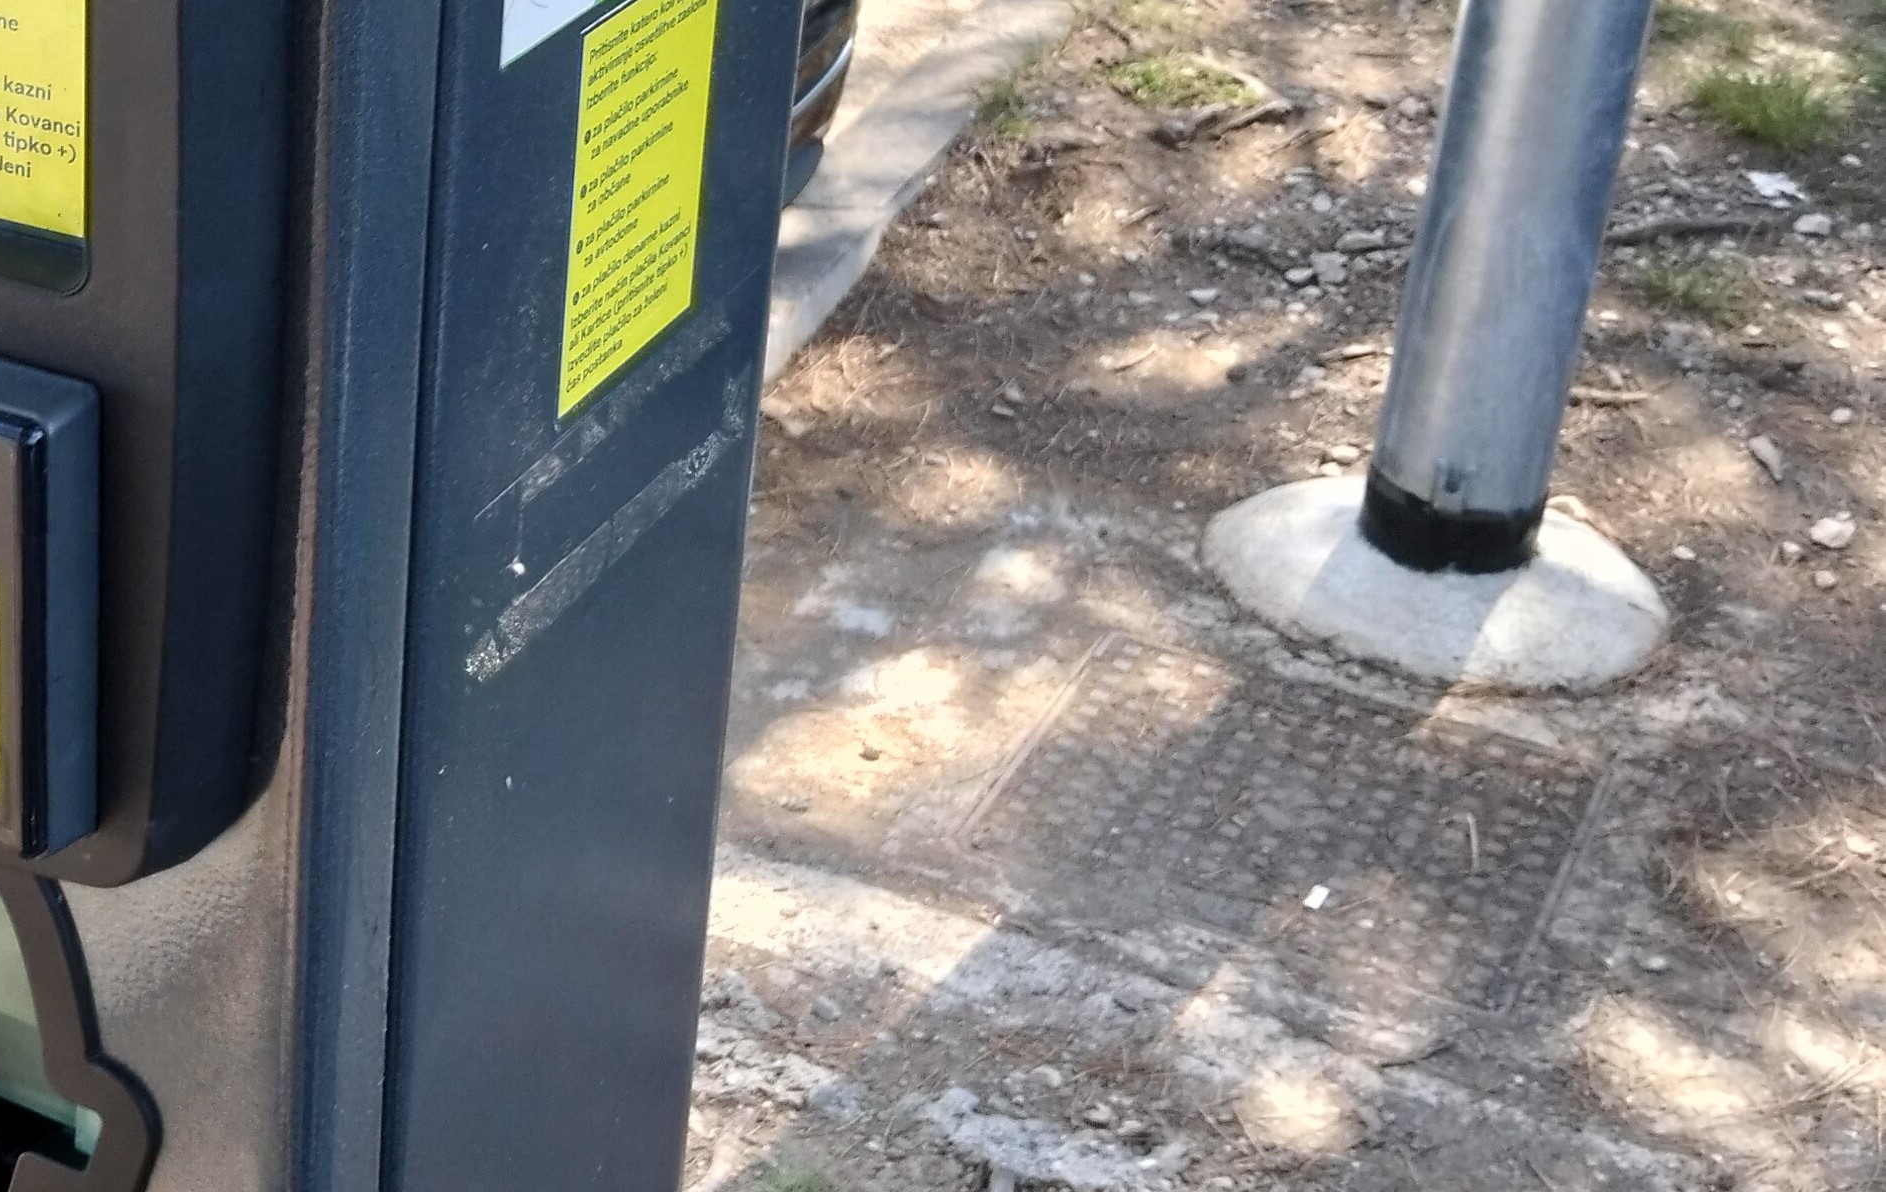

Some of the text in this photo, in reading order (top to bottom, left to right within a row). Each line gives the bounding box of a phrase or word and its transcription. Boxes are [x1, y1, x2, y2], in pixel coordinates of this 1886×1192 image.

[4, 75, 51, 100] kazni
[6, 106, 81, 138] Kovanci
[3, 131, 52, 156] tipko
[57, 144, 76, 164] +)
